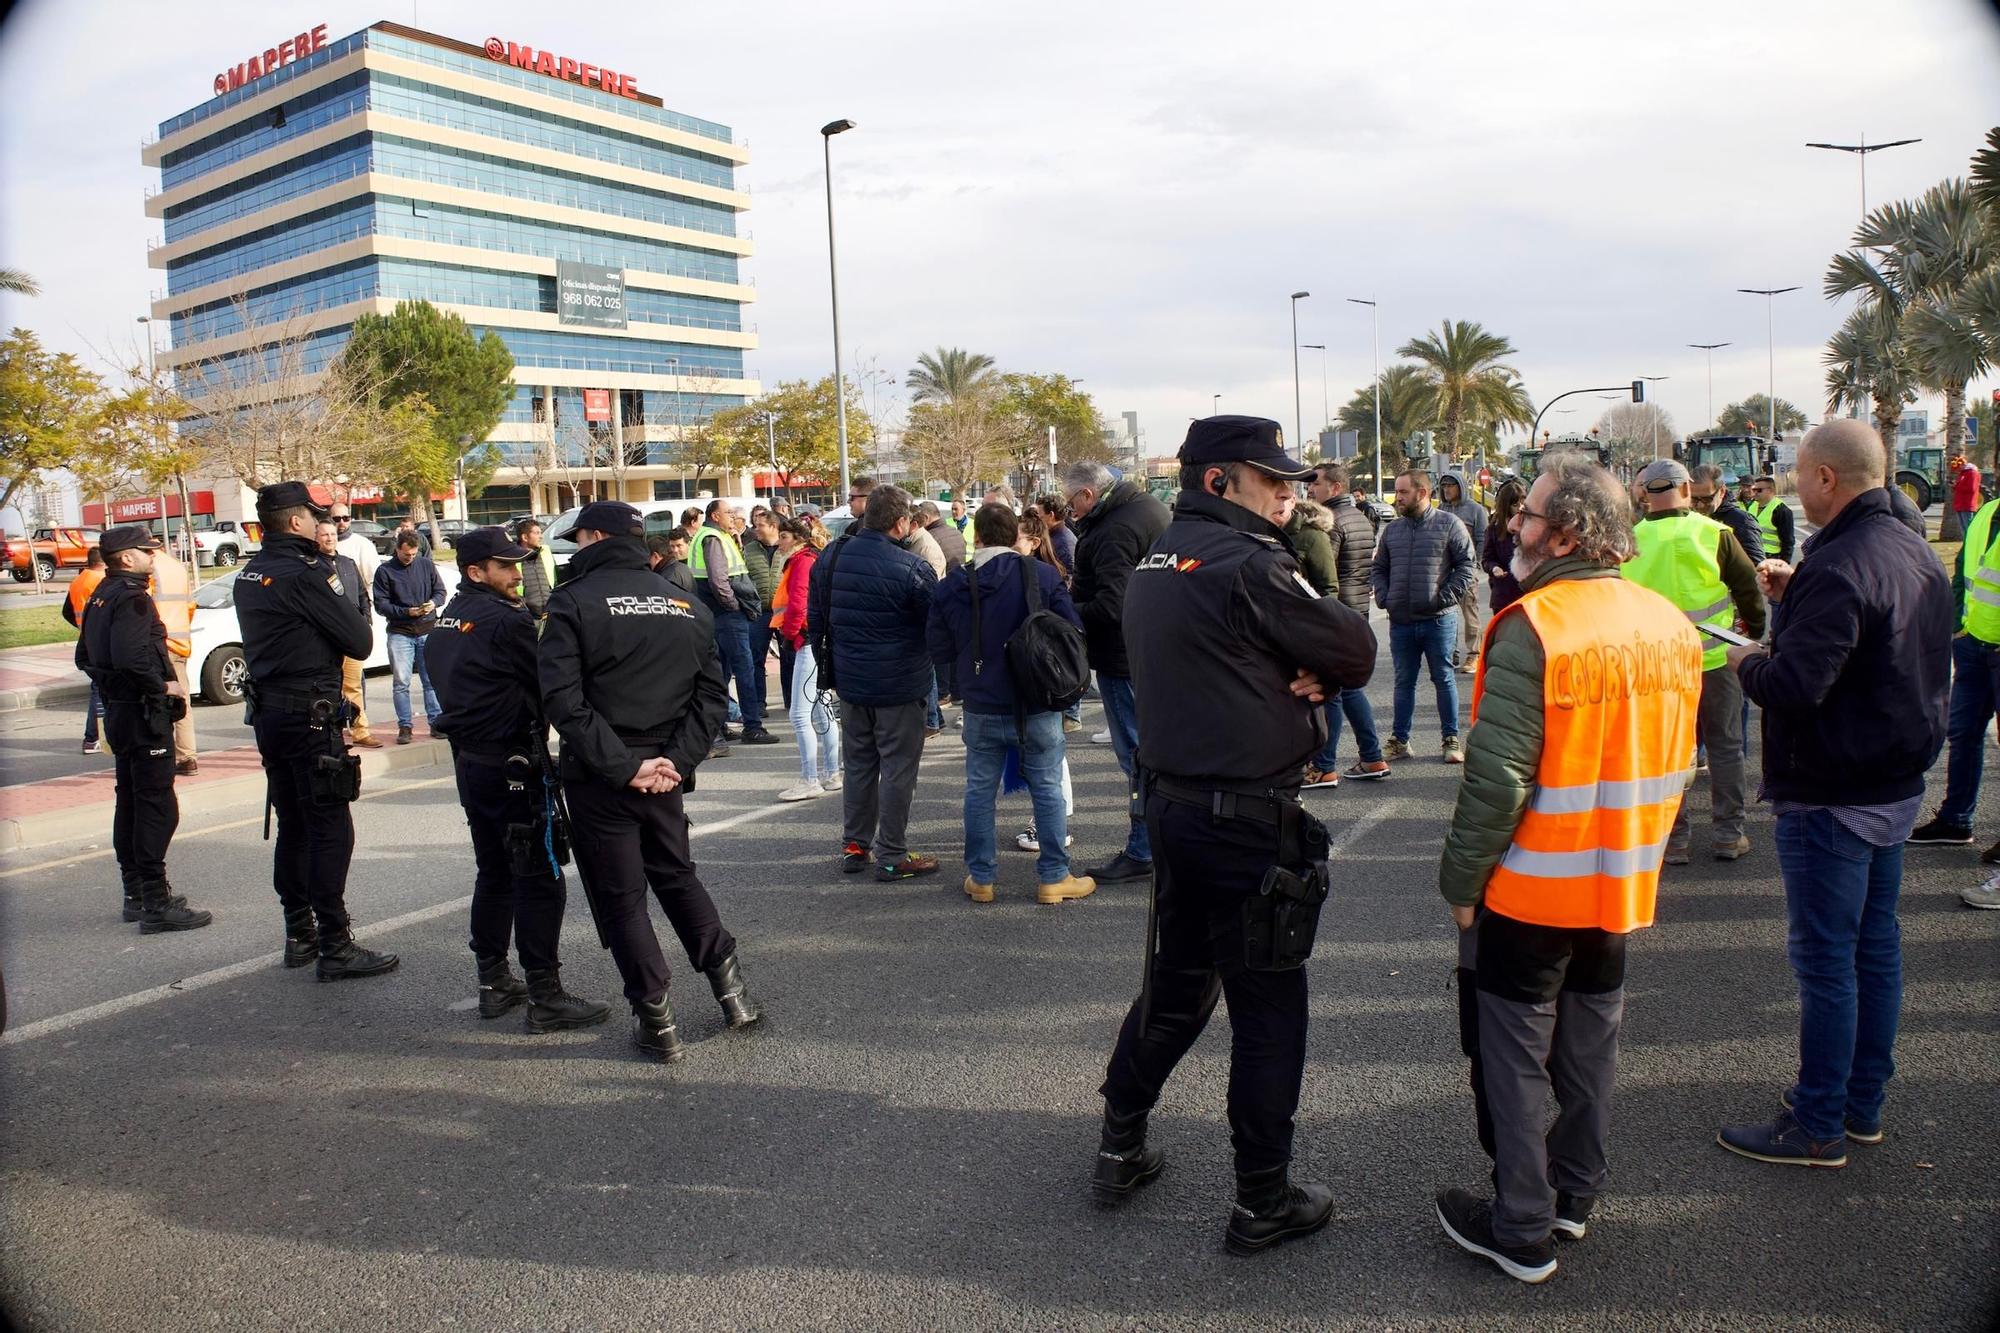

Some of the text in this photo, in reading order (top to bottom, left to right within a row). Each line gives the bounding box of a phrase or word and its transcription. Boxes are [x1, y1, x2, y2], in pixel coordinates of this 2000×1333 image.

[228, 23, 328, 89] MAPFRE
[508, 41, 639, 99] MAPFRE
[563, 292, 622, 309] 968 062 025
[122, 502, 157, 517] MAPFRE
[606, 596, 678, 607] POLICIA
[609, 605, 696, 619] NACIONAL
